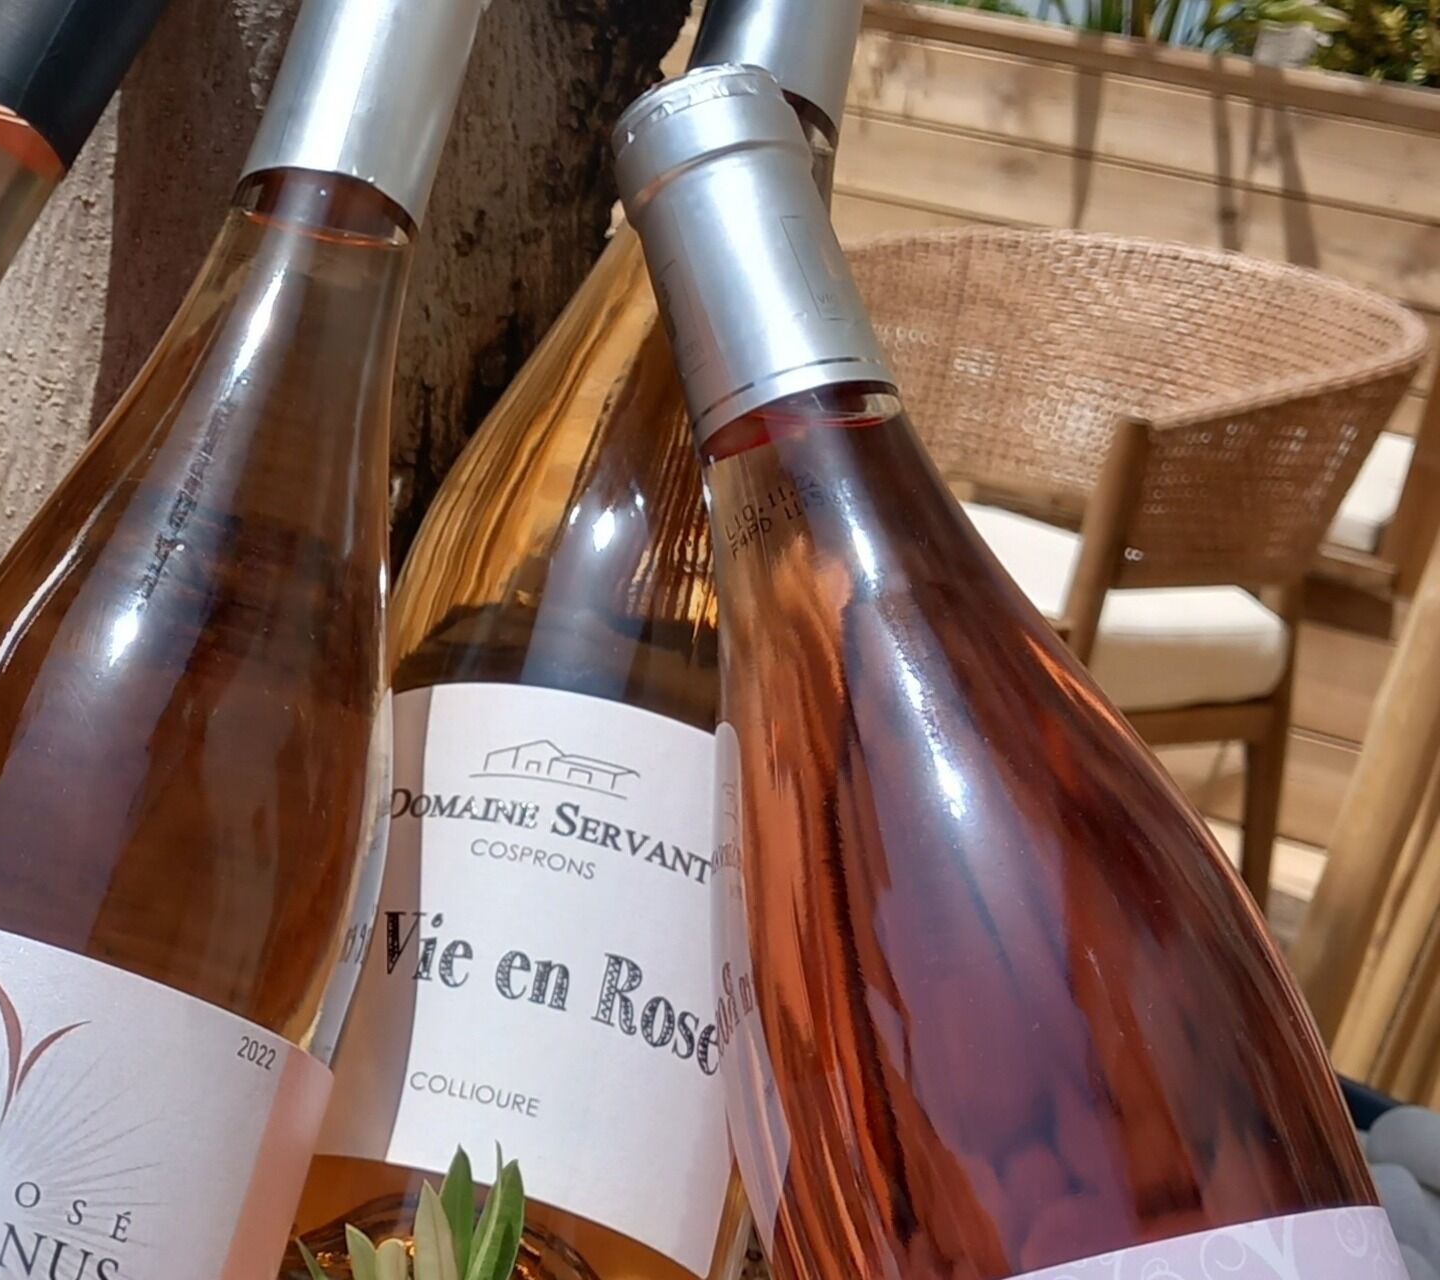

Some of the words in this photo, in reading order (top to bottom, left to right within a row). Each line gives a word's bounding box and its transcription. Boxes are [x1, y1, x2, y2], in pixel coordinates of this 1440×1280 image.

[390, 786, 539, 830] DOMAINE
[550, 800, 713, 887] SERVANT
[469, 838, 597, 881] COSPRONS
[384, 910, 474, 989] Vie
[495, 947, 570, 1012] en
[590, 951, 724, 1077] Rose
[235, 1034, 279, 1072] 2022
[409, 1069, 542, 1119] COLLIOURE
